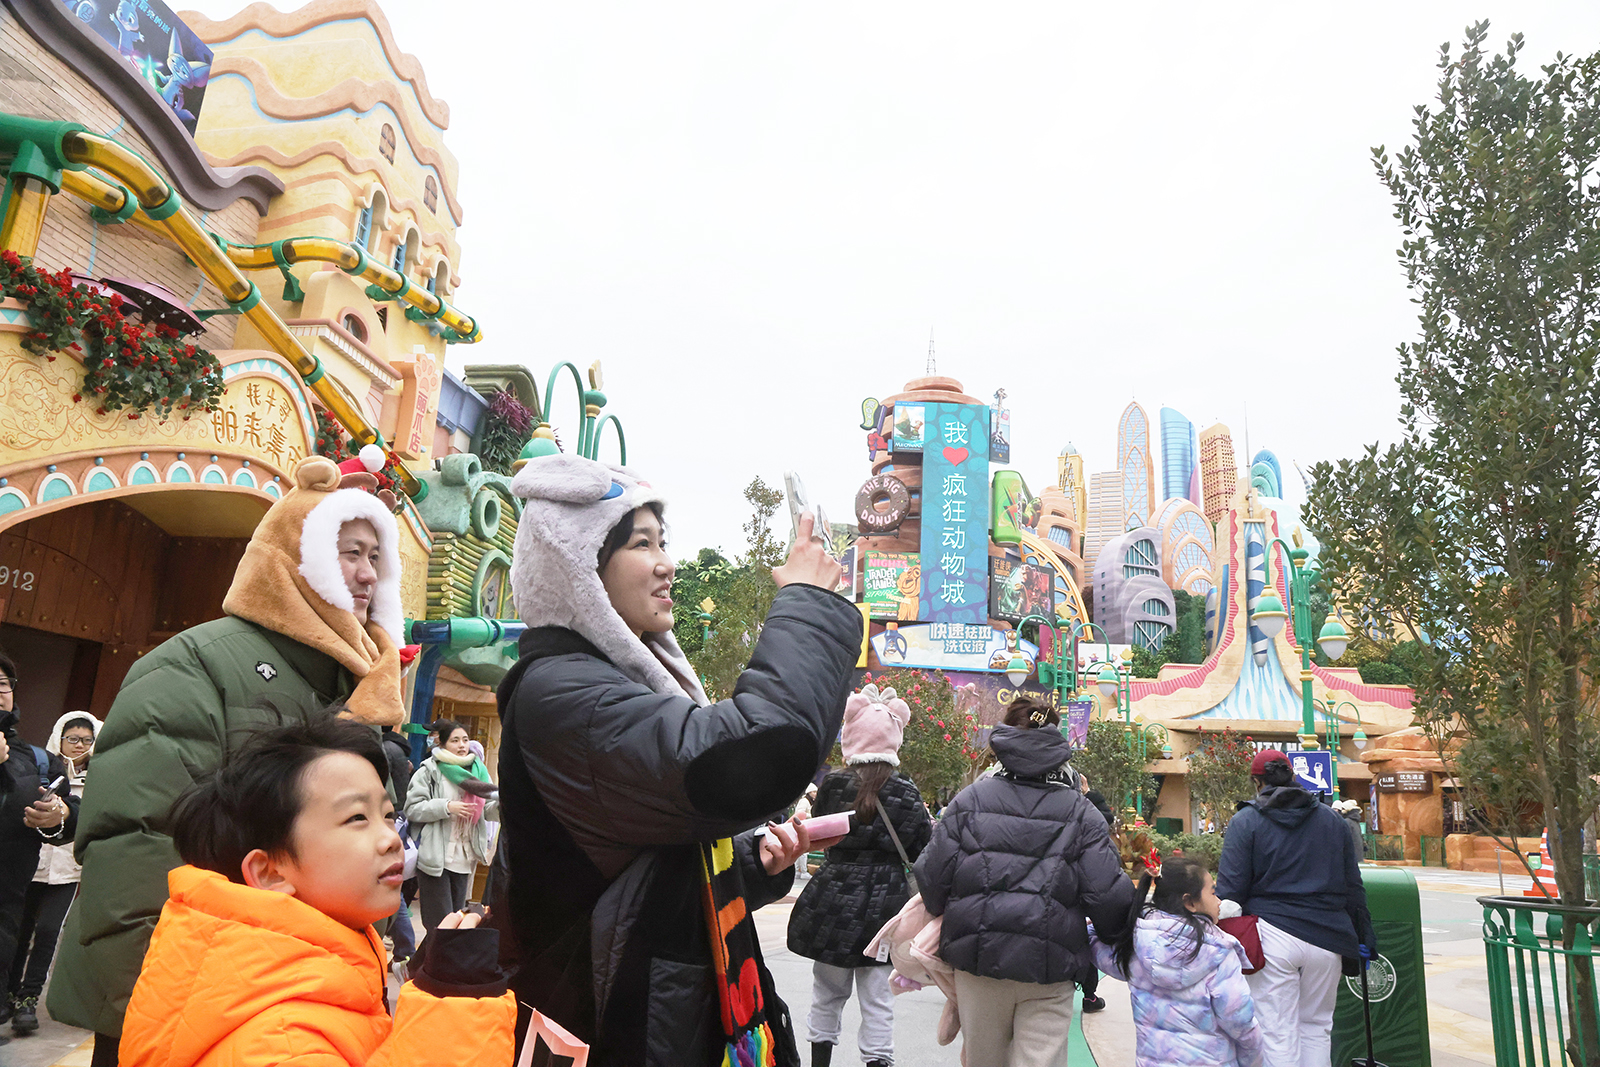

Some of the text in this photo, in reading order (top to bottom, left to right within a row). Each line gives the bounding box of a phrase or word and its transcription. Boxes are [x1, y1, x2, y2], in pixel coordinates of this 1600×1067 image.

[408, 391, 428, 453] 丽爪店
[944, 421, 969, 445] 我
[861, 478, 901, 495] THE BIG
[860, 509, 899, 525] DONUT
[940, 473, 968, 604] 疯狂动物城
[868, 559, 908, 568] NIGHTS
[867, 567, 897, 580] TRADER
[930, 622, 992, 639] 快速祛斑
[944, 640, 985, 653] 洗衣液
